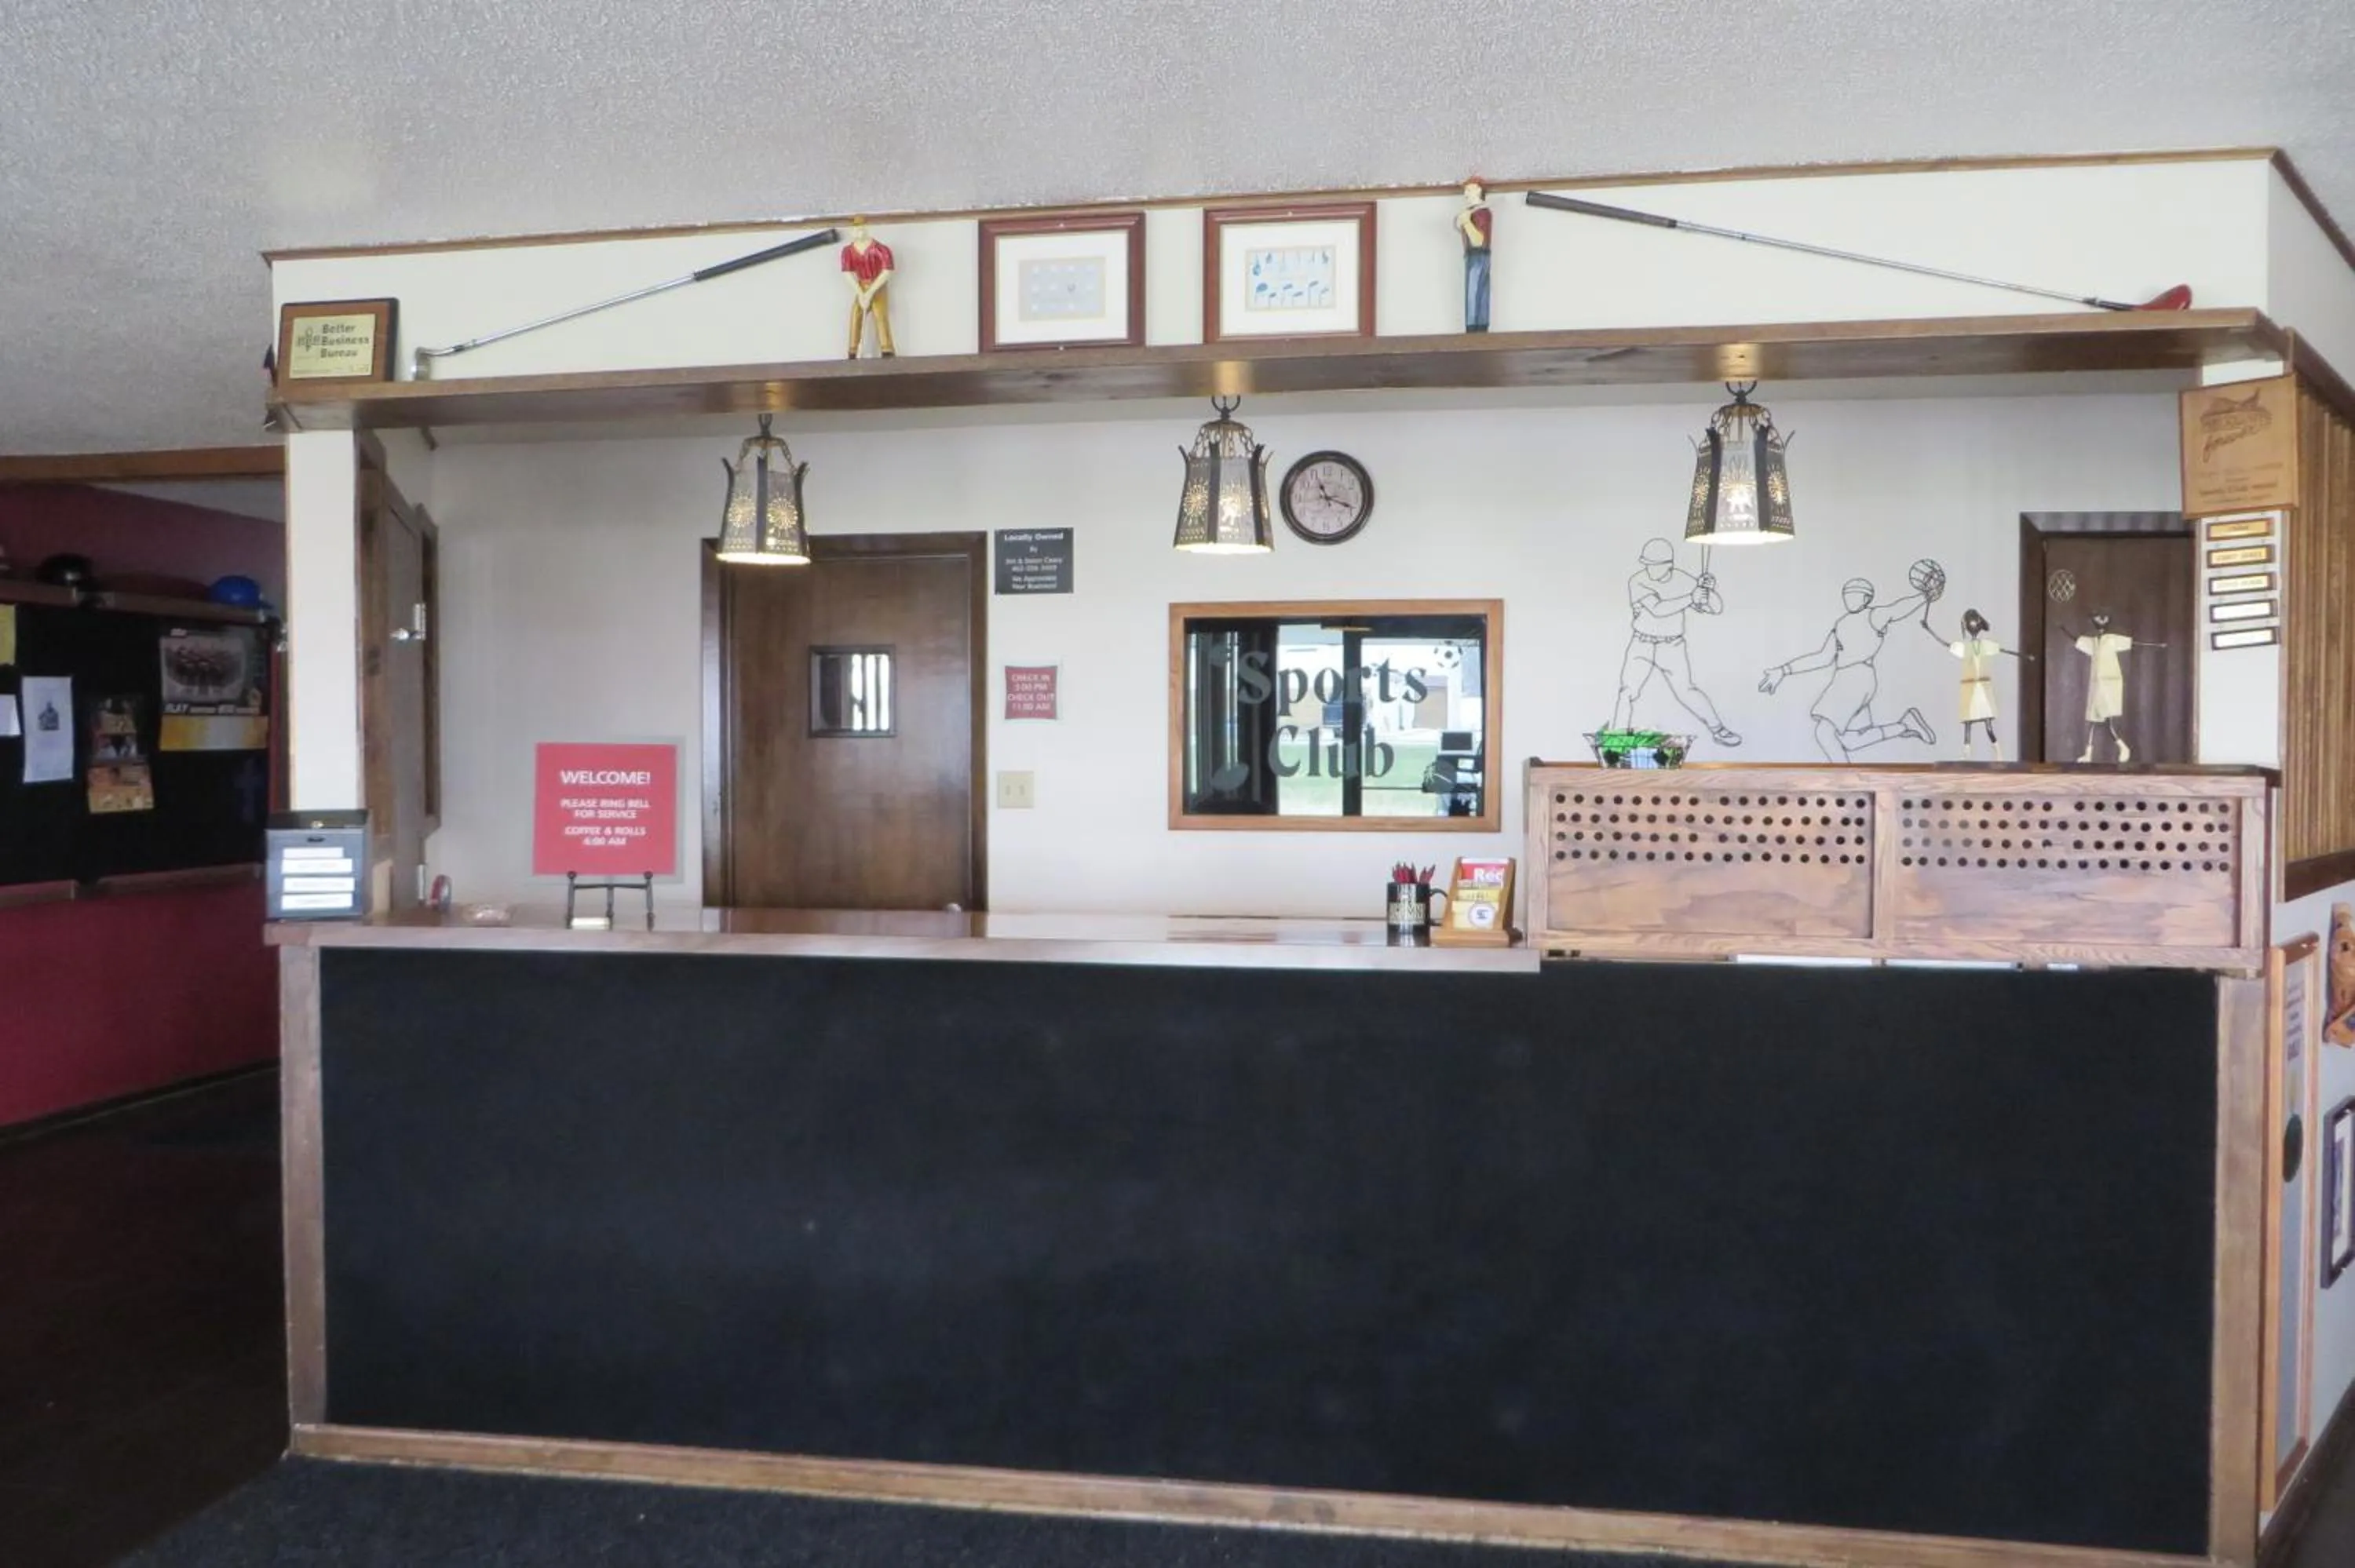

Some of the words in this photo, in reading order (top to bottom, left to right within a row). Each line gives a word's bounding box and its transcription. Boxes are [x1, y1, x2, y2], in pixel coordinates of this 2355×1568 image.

[322, 323, 356, 334] Better
[321, 335, 369, 346] Business
[320, 348, 358, 359] Bureau
[1004, 534, 1032, 542] Locally
[1035, 532, 1064, 541] Owned
[1237, 650, 1429, 717] Sports
[1007, 693, 1035, 702] CHECK
[1036, 693, 1054, 702] OUT
[1267, 723, 1395, 779] Club
[560, 771, 651, 785] WELCOME!
[560, 798, 599, 808] PLEASE
[600, 798, 625, 808] RING
[626, 798, 651, 808] BELL
[574, 809, 597, 819] FOR
[598, 809, 637, 819] SERVICE
[564, 826, 602, 836] COFFEE
[614, 826, 647, 836] ROLLS
[608, 837, 626, 845] AM
